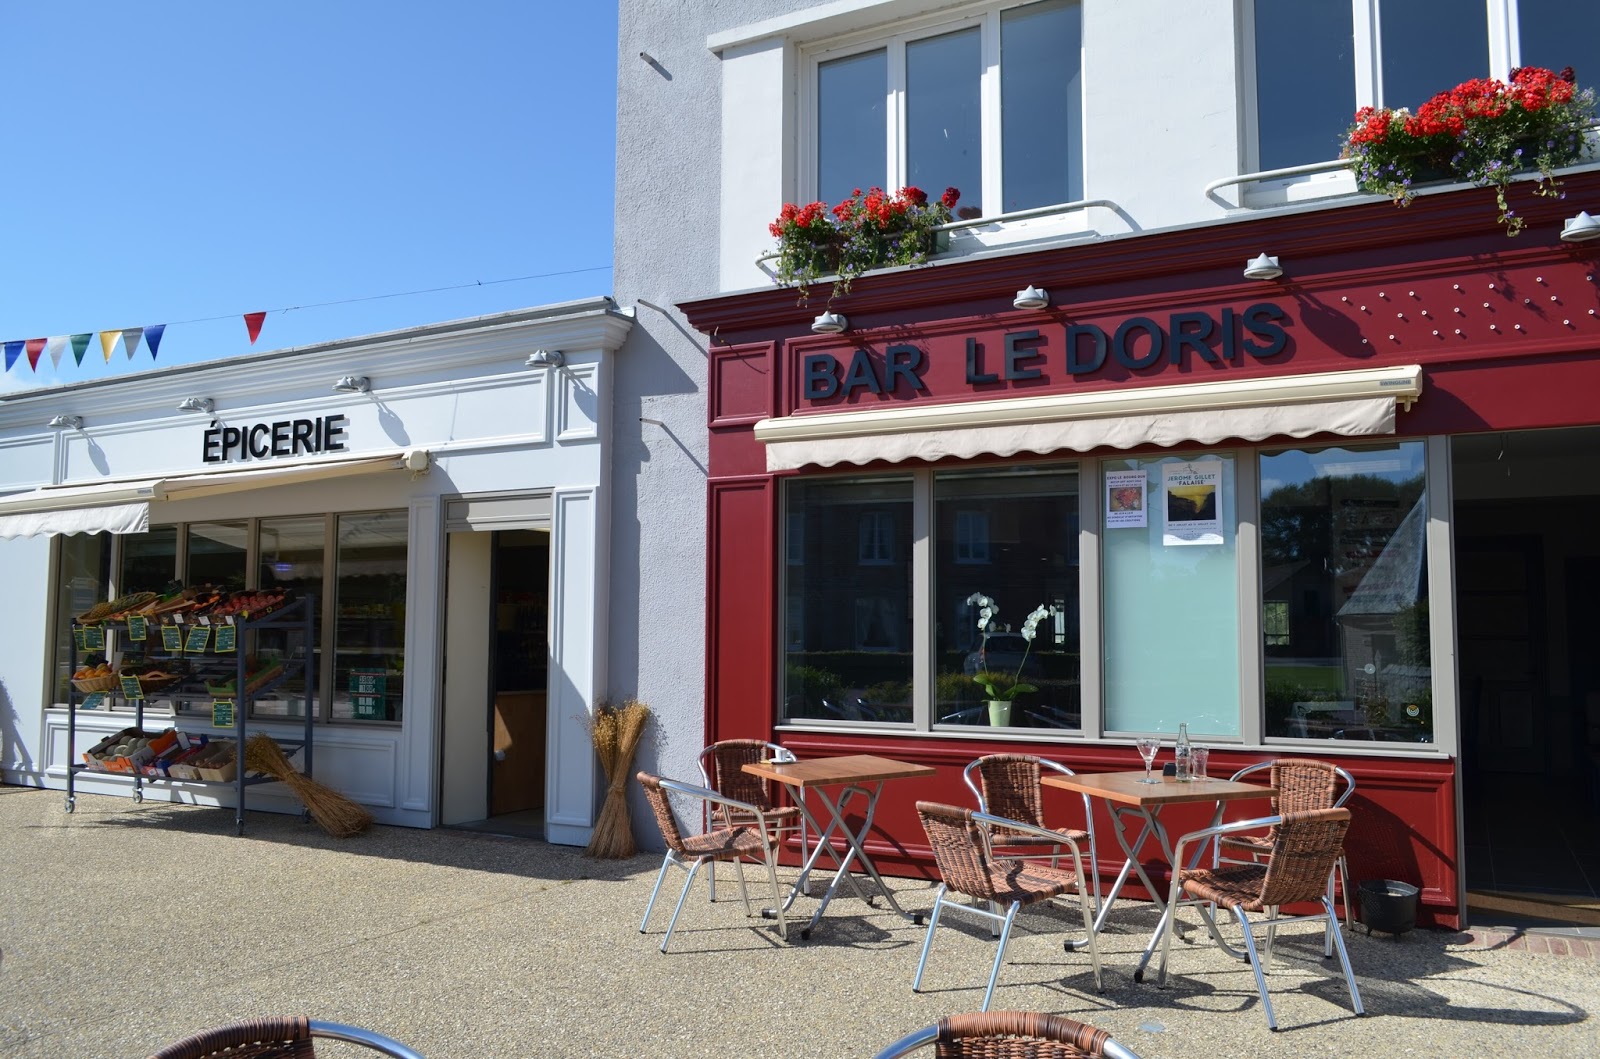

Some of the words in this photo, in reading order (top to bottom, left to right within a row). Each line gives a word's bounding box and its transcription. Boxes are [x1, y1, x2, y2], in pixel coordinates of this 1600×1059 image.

[803, 344, 925, 400] BAR
[965, 329, 1043, 385] LE
[1066, 302, 1287, 376] DORIS
[202, 413, 345, 463] ÉPICERIE
